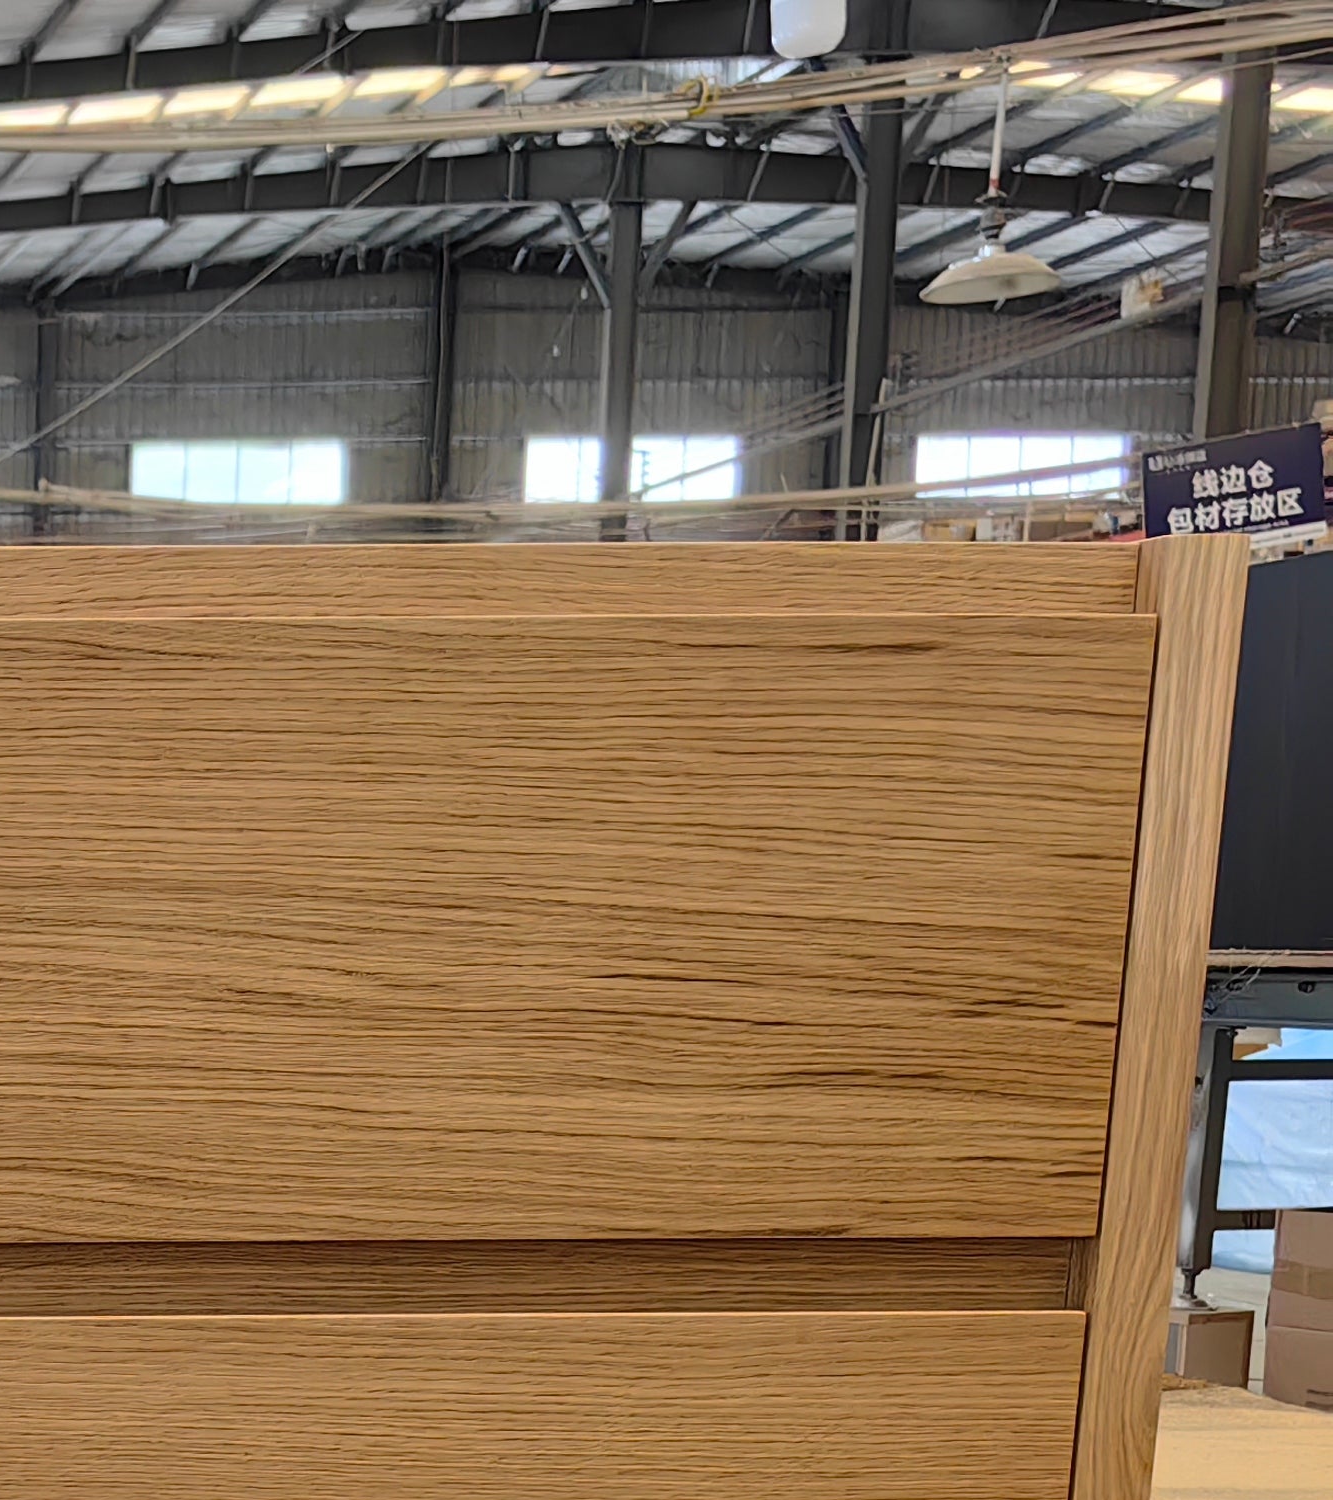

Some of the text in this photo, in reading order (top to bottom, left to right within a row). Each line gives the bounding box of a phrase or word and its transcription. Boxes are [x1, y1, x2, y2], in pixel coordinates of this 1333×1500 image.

[1191, 459, 1275, 500] 线边仓
[1166, 486, 1305, 535] 包材存放区
